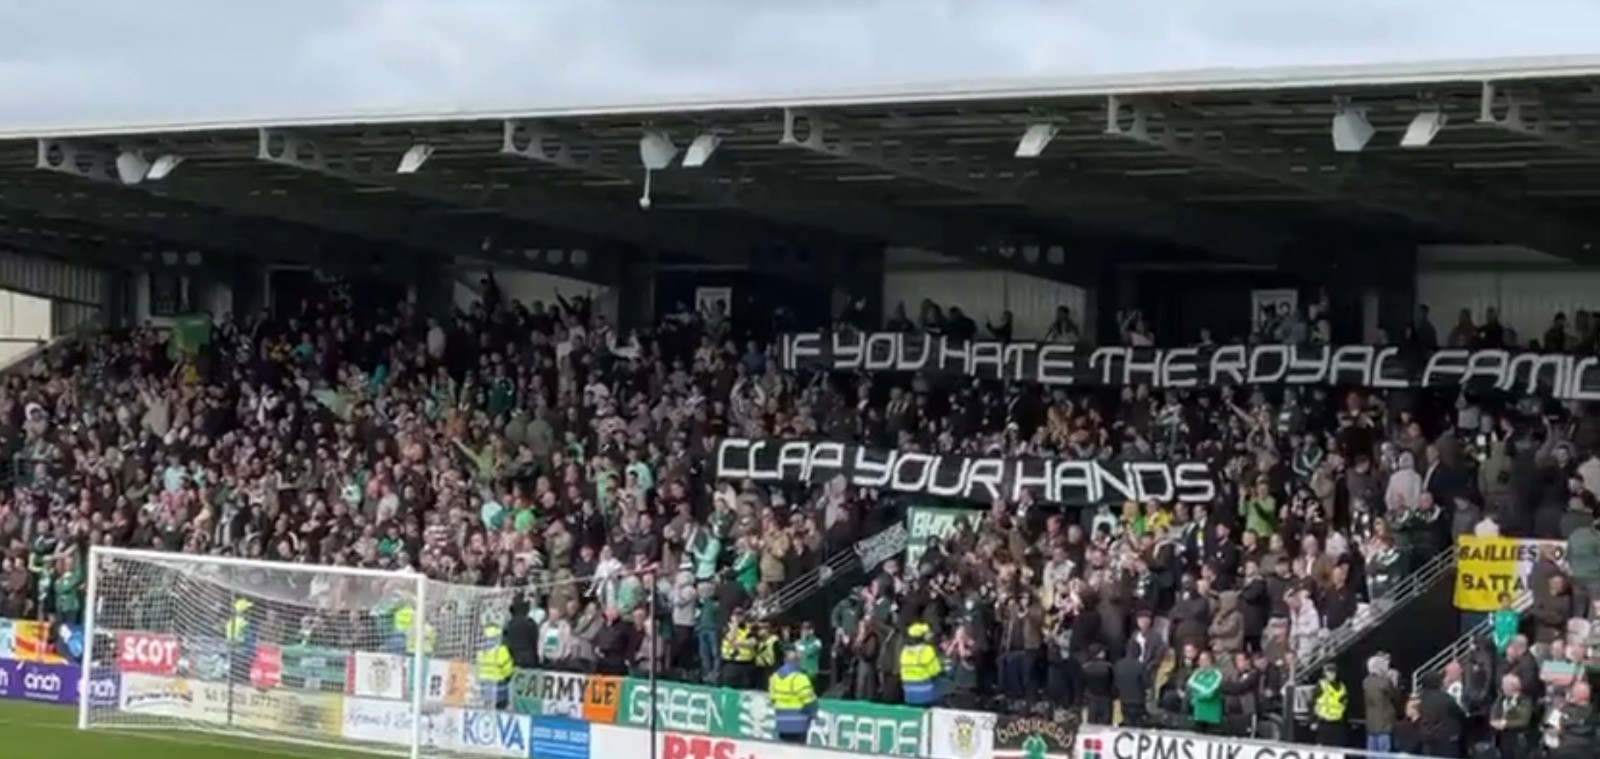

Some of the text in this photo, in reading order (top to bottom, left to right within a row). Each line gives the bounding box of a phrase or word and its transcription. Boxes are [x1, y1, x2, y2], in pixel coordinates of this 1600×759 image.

[783, 333, 820, 370] IF
[832, 332, 931, 370] YOU
[939, 336, 1075, 384] HATE
[1089, 346, 1198, 388] THE
[1209, 345, 1409, 387] ROYAL
[717, 438, 1216, 502] CLAP YOUR HANDS
[1461, 573, 1530, 592] BATTA
[123, 636, 178, 666] SCOT
[24, 667, 61, 693] cinch
[77, 678, 116, 699] cnch
[628, 684, 919, 758] GREEN RIGADE
